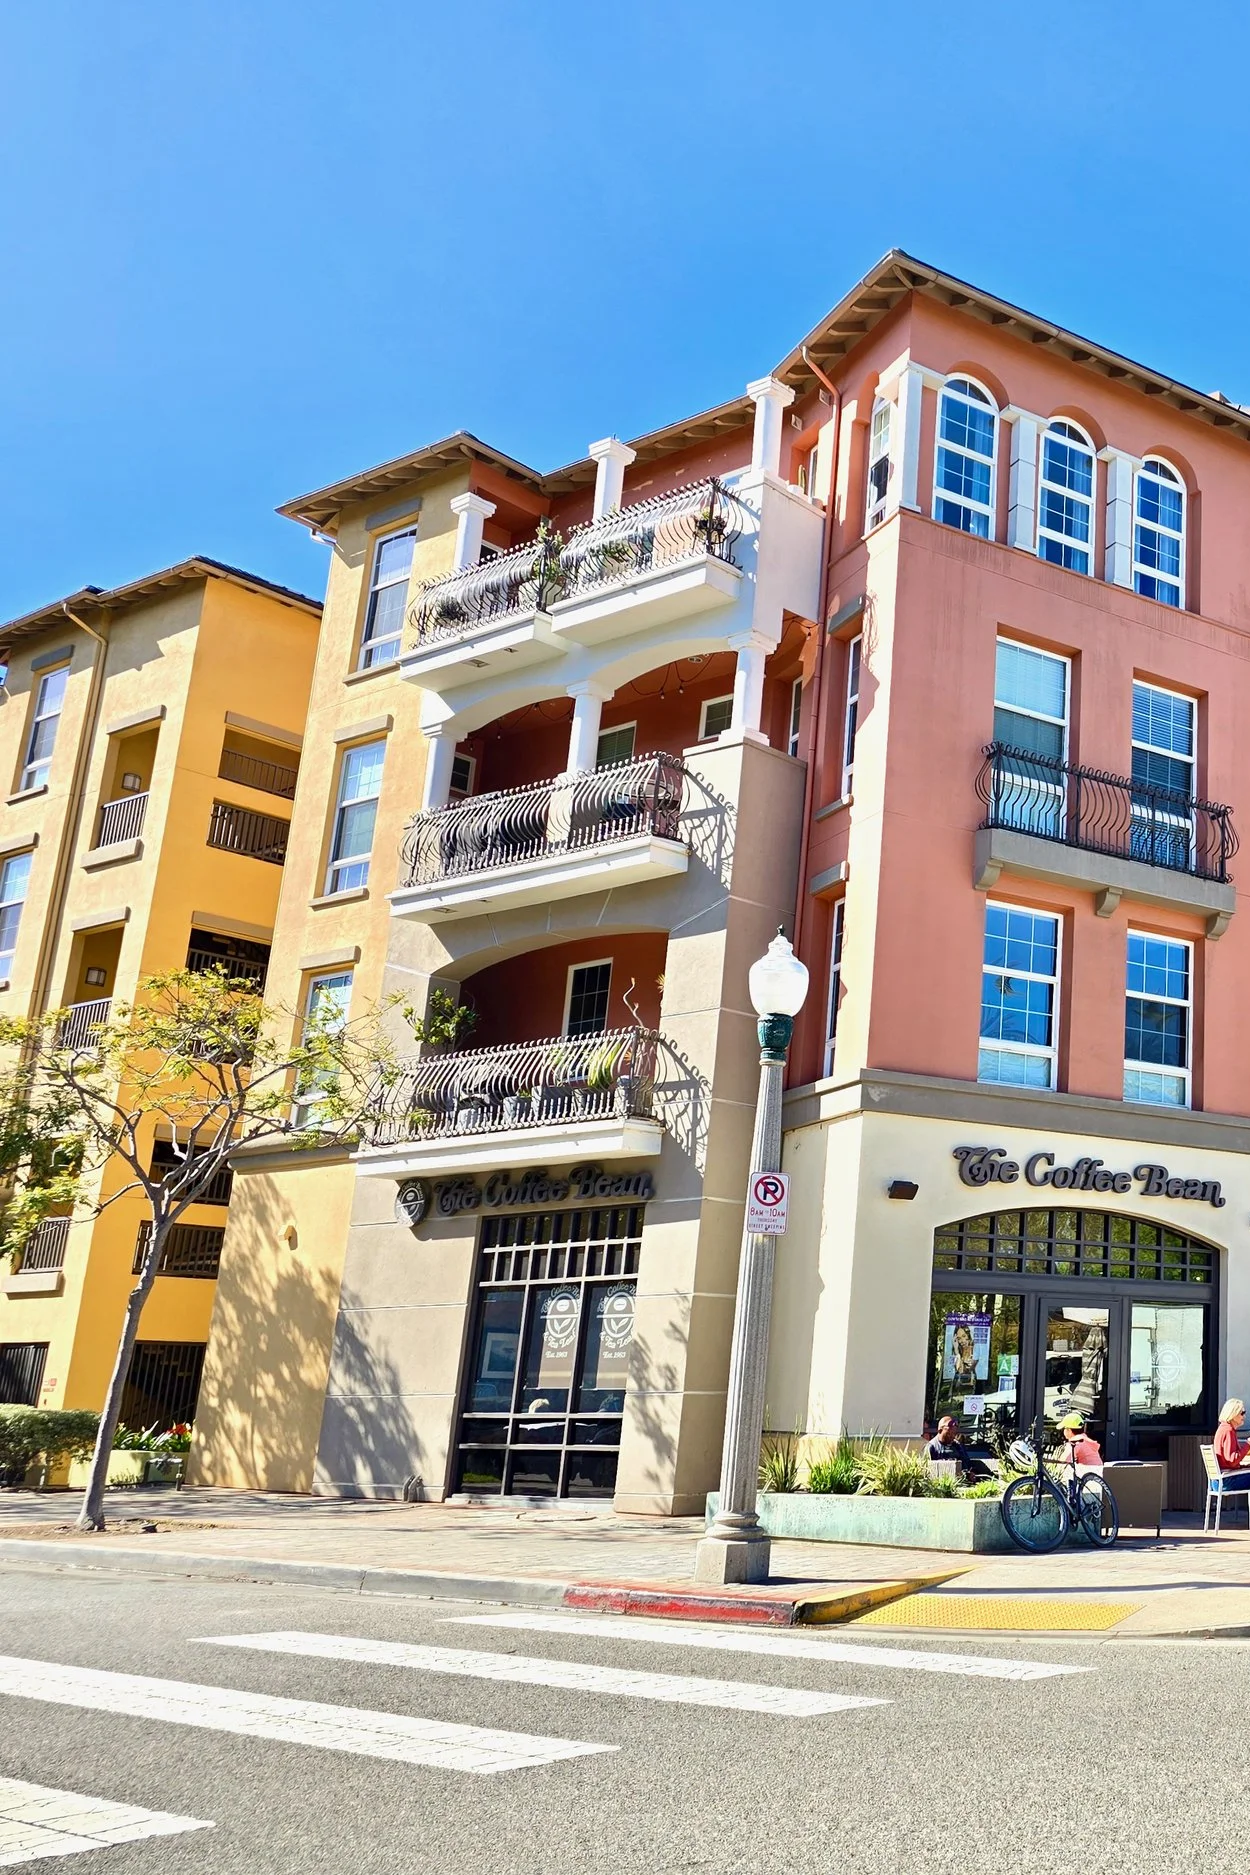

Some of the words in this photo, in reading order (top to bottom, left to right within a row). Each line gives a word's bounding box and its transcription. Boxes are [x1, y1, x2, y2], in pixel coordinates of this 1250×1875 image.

[953, 1146, 1020, 1187] The
[1024, 1152, 1133, 1194] Coffee
[1133, 1164, 1227, 1208] Bean
[433, 1177, 482, 1216] The
[482, 1171, 569, 1207] Coffee
[568, 1164, 654, 1200] Bean
[550, 1284, 572, 1298] Coffee
[607, 1281, 629, 1297] Coffee
[1000, 1360, 1009, 1371] A
